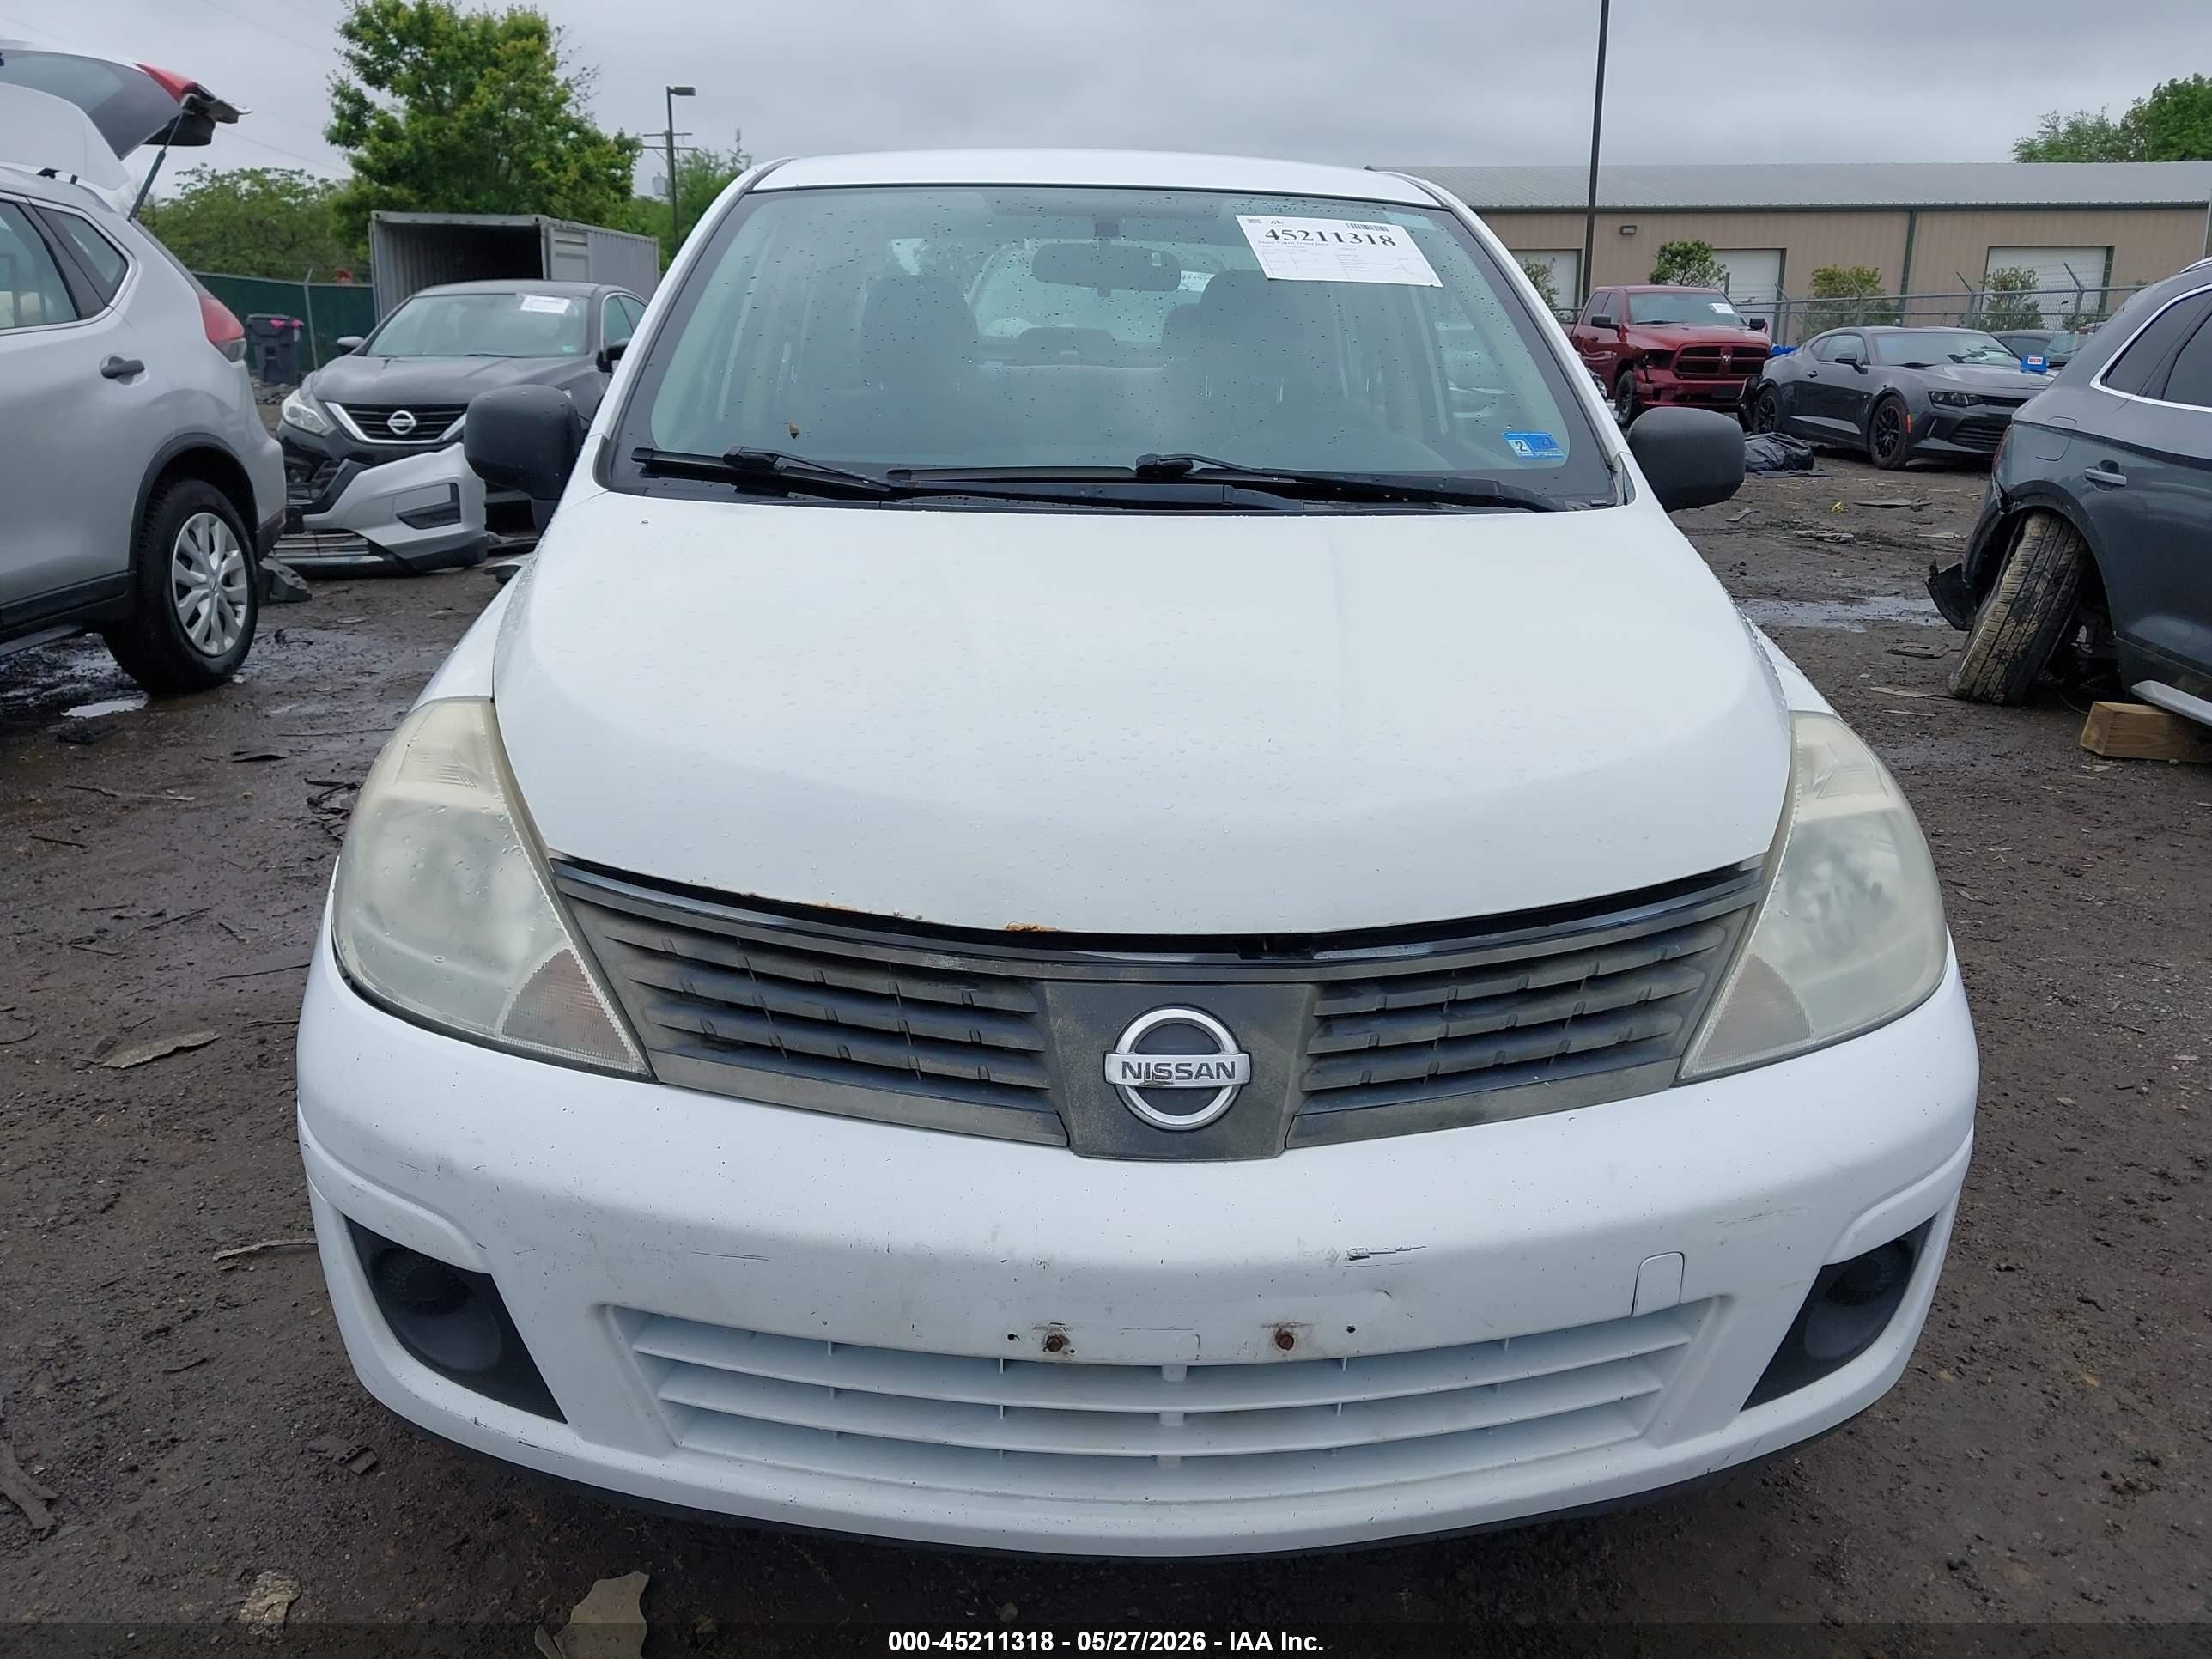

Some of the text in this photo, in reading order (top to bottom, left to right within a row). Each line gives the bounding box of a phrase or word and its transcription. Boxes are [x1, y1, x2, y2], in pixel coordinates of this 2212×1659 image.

[1265, 228, 1397, 246] 45211318
[1515, 440, 1528, 452] 2
[1121, 1060, 1236, 1081] NISSAN
